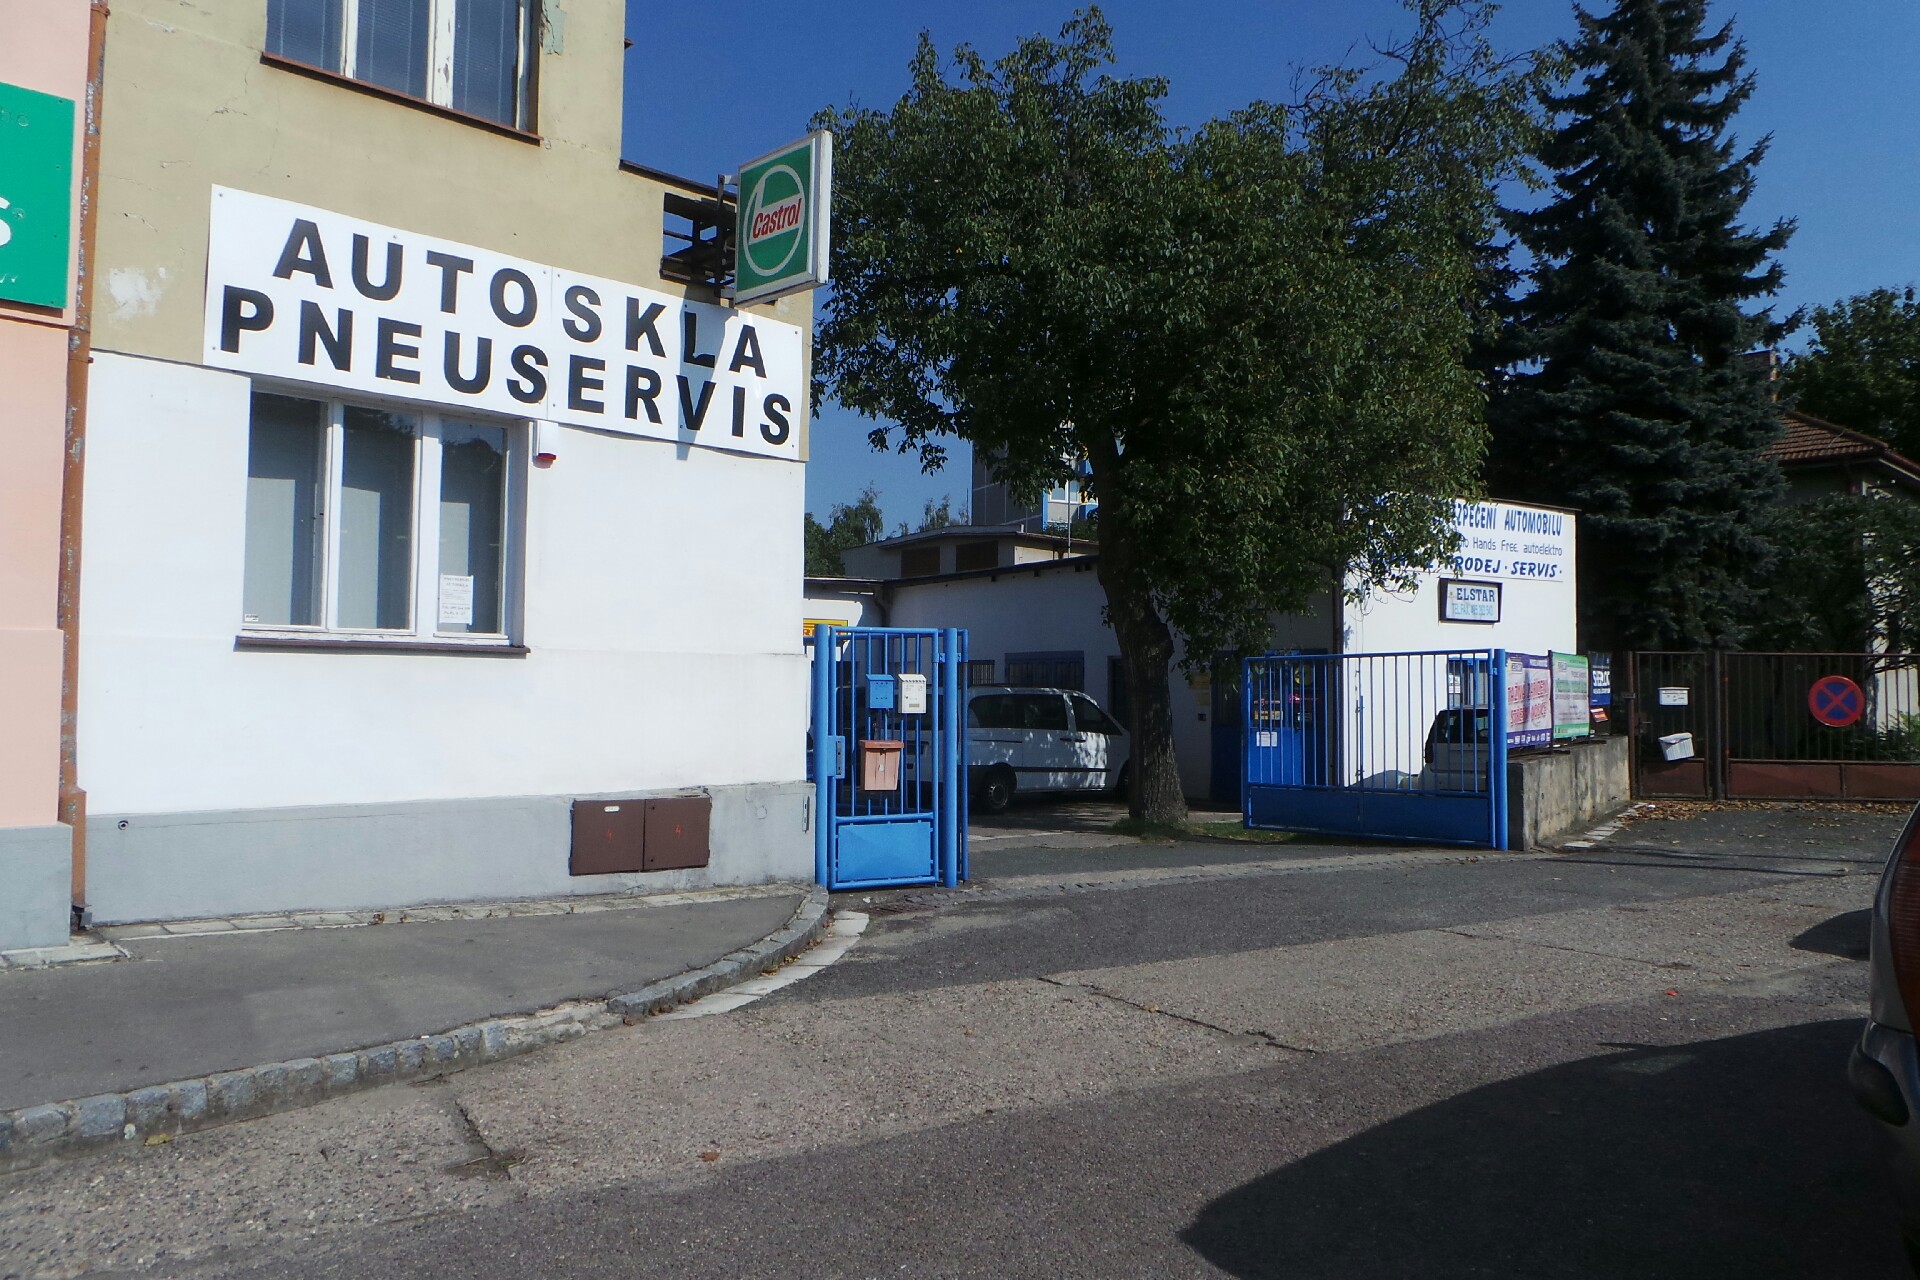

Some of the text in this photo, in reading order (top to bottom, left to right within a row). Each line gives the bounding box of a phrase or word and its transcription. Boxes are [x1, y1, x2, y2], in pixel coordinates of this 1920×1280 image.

[752, 198, 803, 240] Castrol
[220, 284, 792, 446] PNEUSERVIS
[1472, 536, 1497, 551] Hands
[1523, 543, 1563, 557] autoelektro
[1456, 587, 1496, 602] ELSTAR
